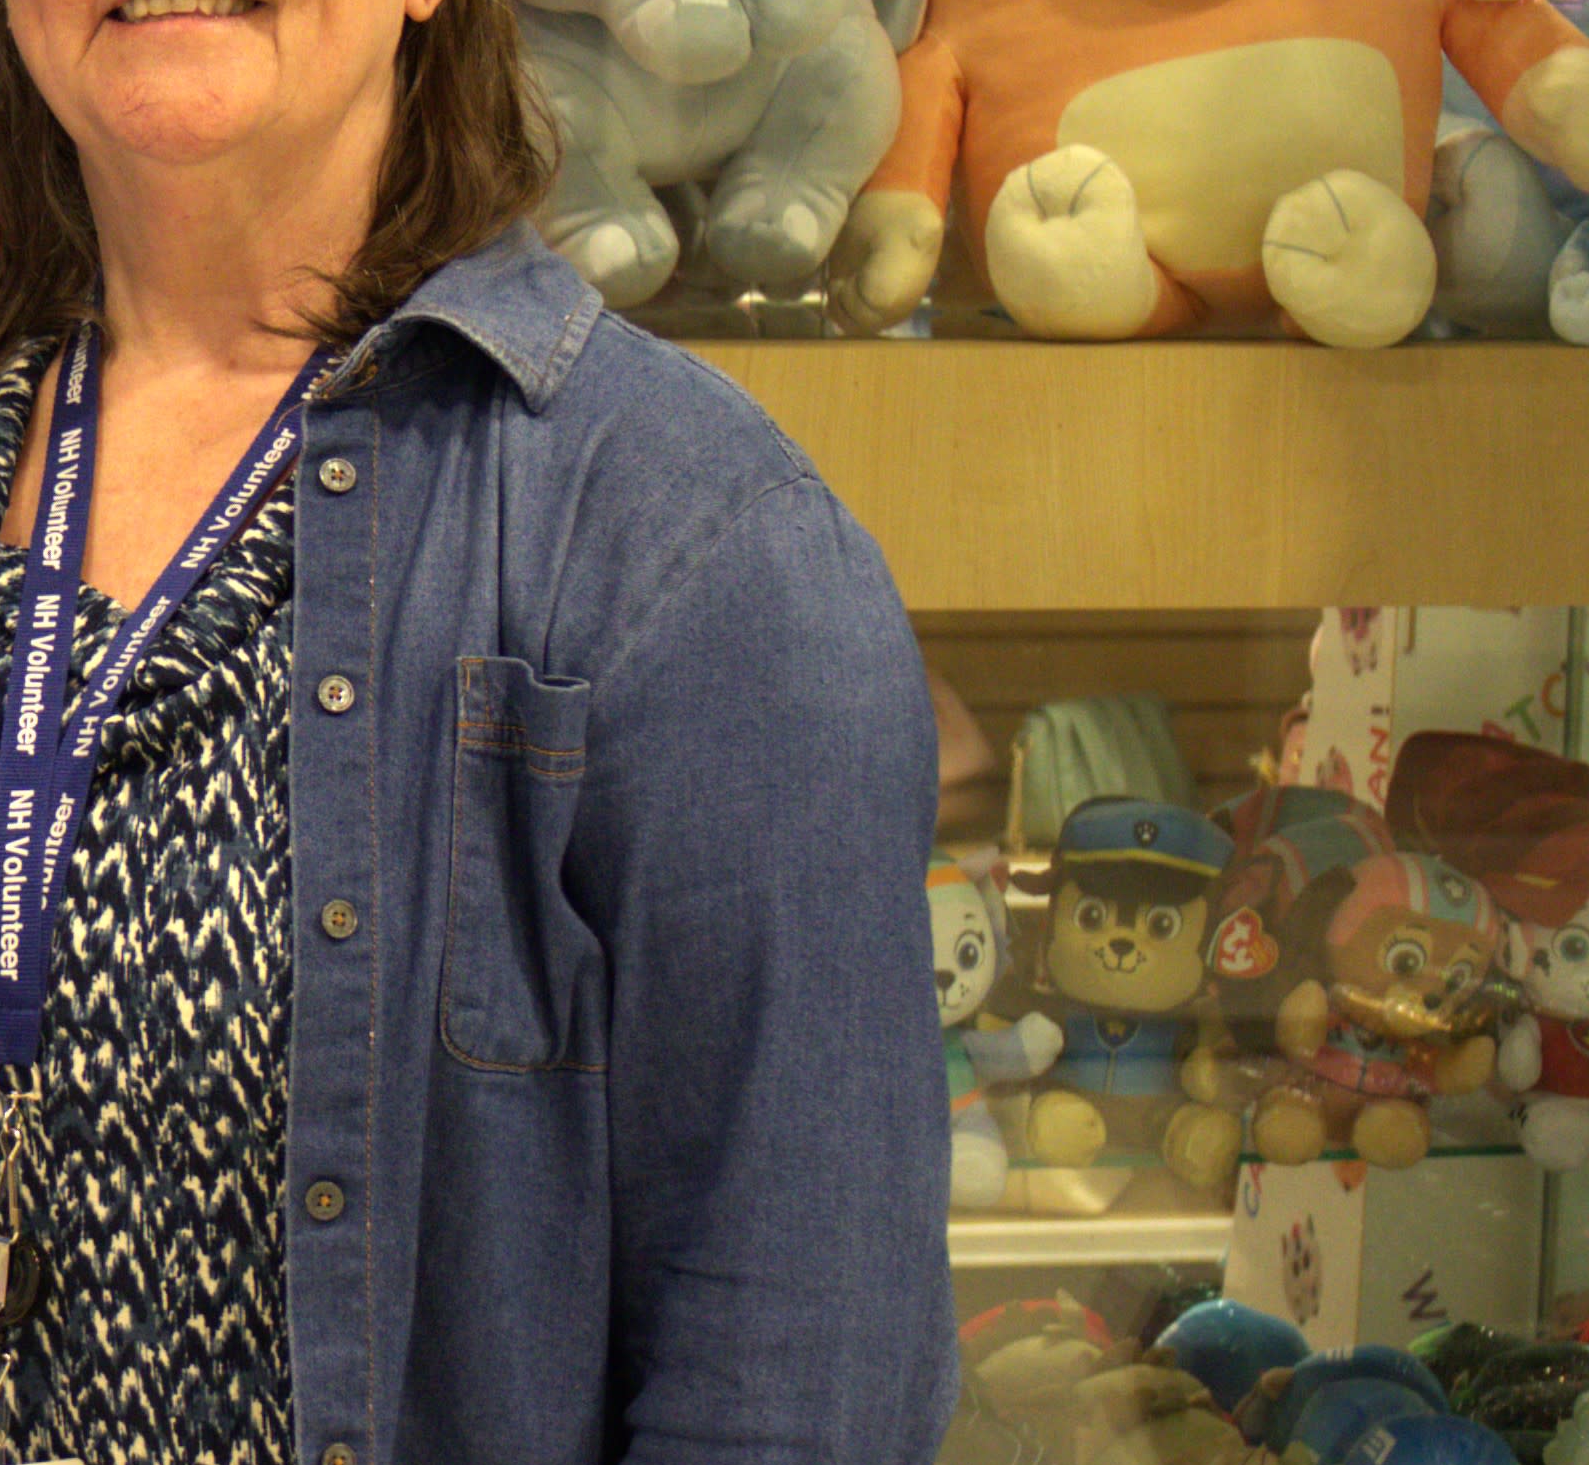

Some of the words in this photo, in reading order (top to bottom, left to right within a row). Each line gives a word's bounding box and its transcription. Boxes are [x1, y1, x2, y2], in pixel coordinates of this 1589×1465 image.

[57, 427, 83, 462] NH
[41, 468, 78, 572] Volunteer
[179, 536, 214, 571] NH
[207, 426, 298, 533] Volunteer
[32, 593, 62, 629] NH
[15, 634, 57, 757] Volunteer
[72, 714, 101, 759] NH
[88, 593, 173, 711] Volunteer
[6, 788, 35, 830] NH
